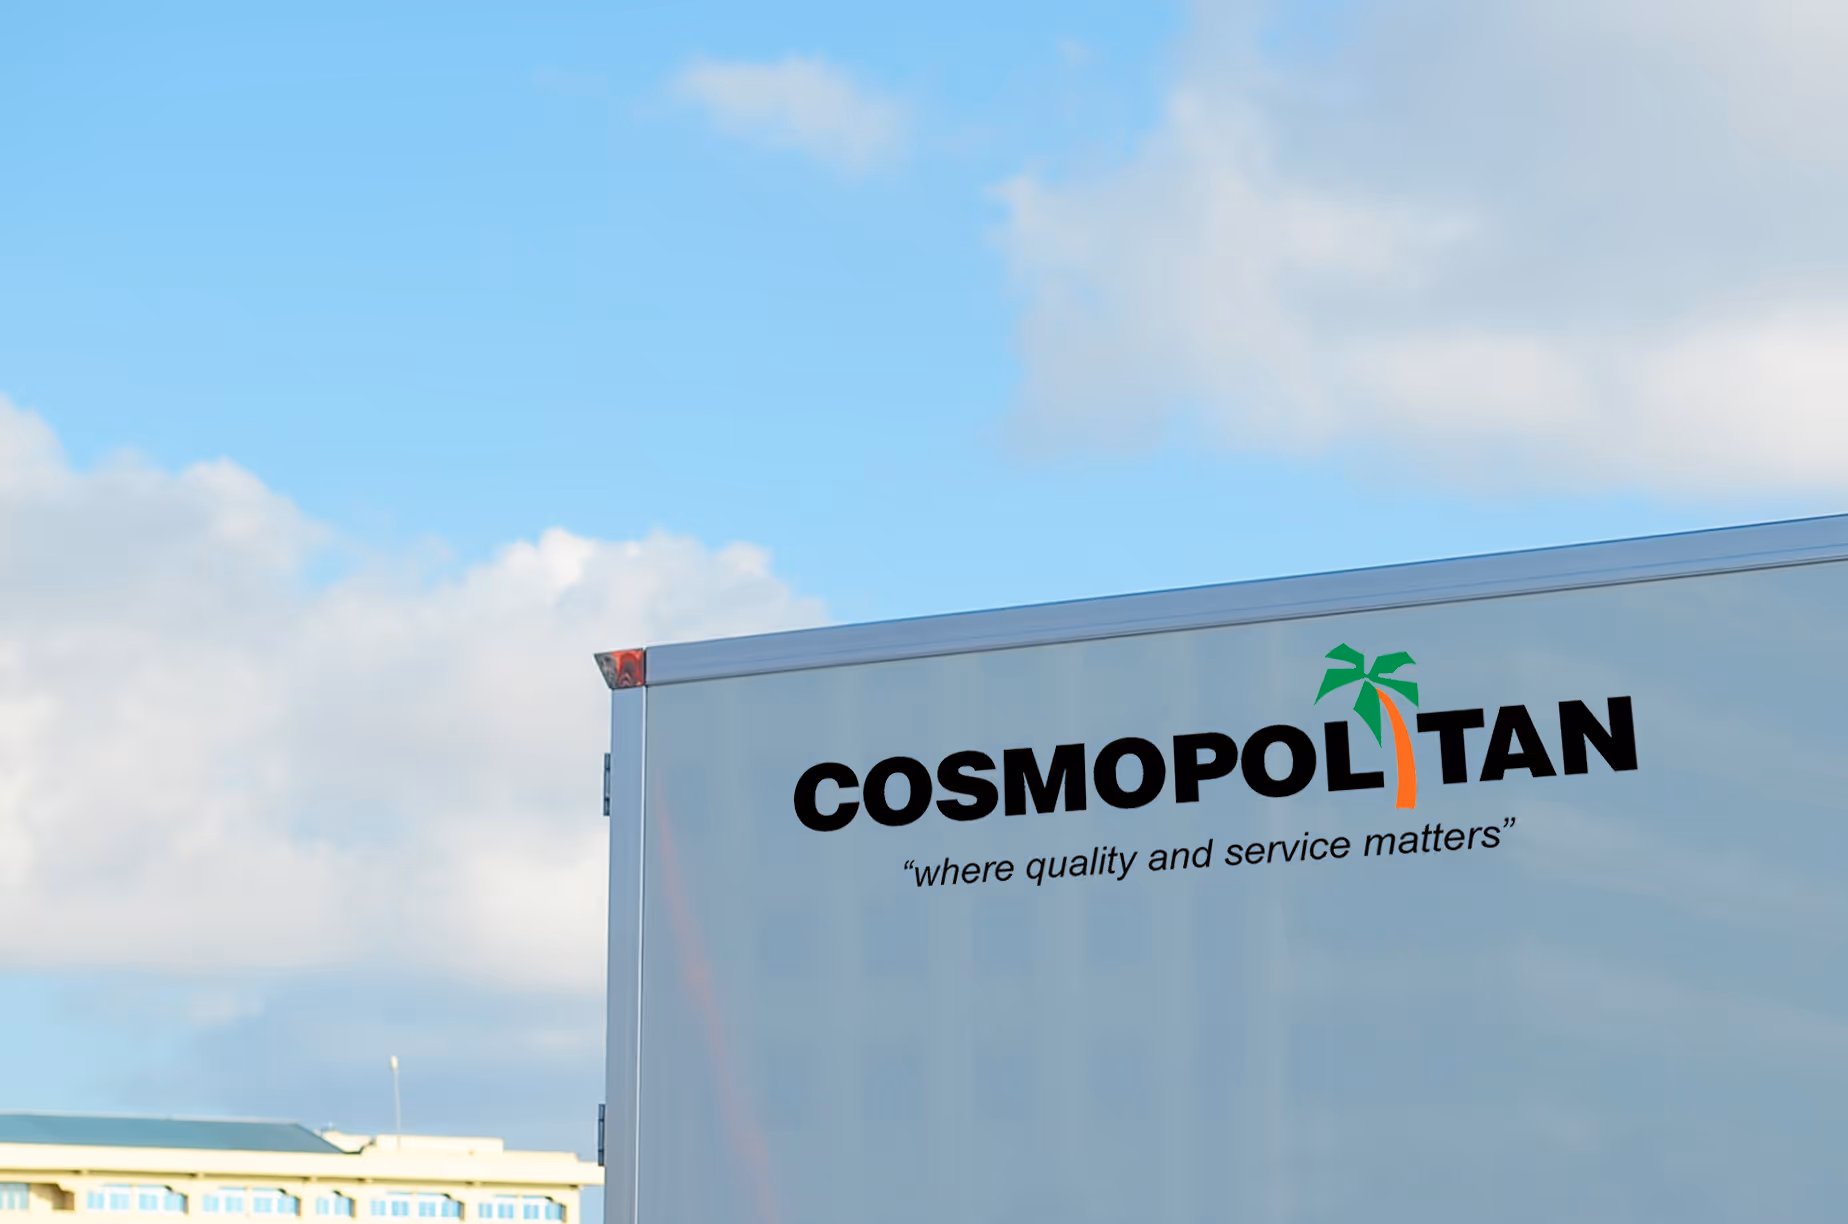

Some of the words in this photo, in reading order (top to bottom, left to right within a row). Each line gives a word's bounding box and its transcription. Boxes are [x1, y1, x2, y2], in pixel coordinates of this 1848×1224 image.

[793, 686, 1639, 833] COSMOPOLITAN
[903, 857, 1015, 888] “where
[1026, 846, 1138, 887] quality
[1148, 838, 1214, 872] and
[1224, 831, 1351, 867] service
[1363, 816, 1517, 857] matters”
